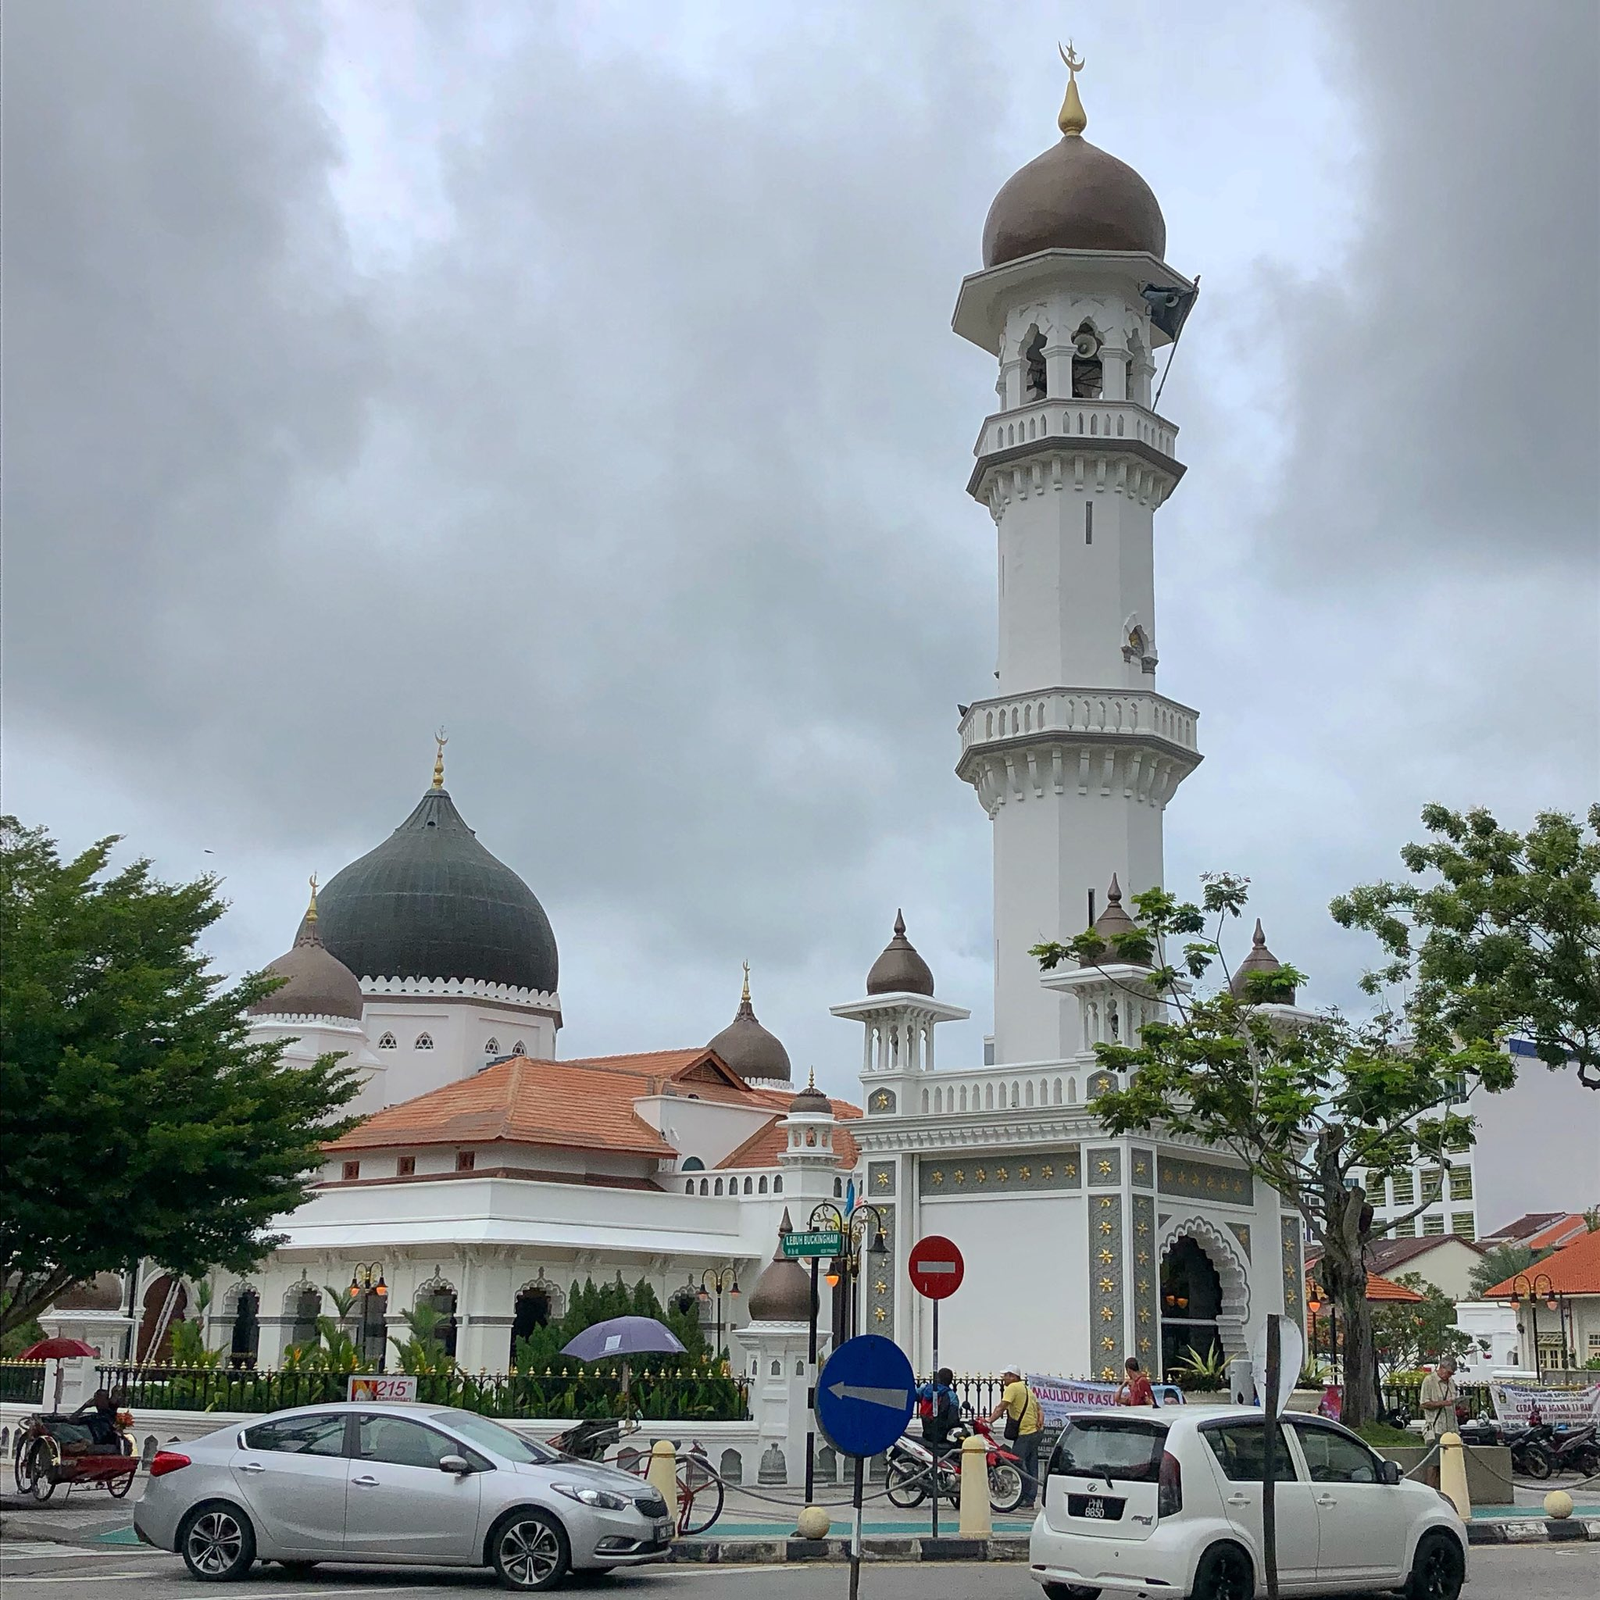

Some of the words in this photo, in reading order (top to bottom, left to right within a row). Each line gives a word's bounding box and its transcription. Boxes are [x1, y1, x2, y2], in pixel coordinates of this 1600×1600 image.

[786, 1235, 803, 1246] LEBUH
[804, 1234, 838, 1245] BUCKINGHAM
[1032, 1386, 1085, 1405] MAULIDUR
